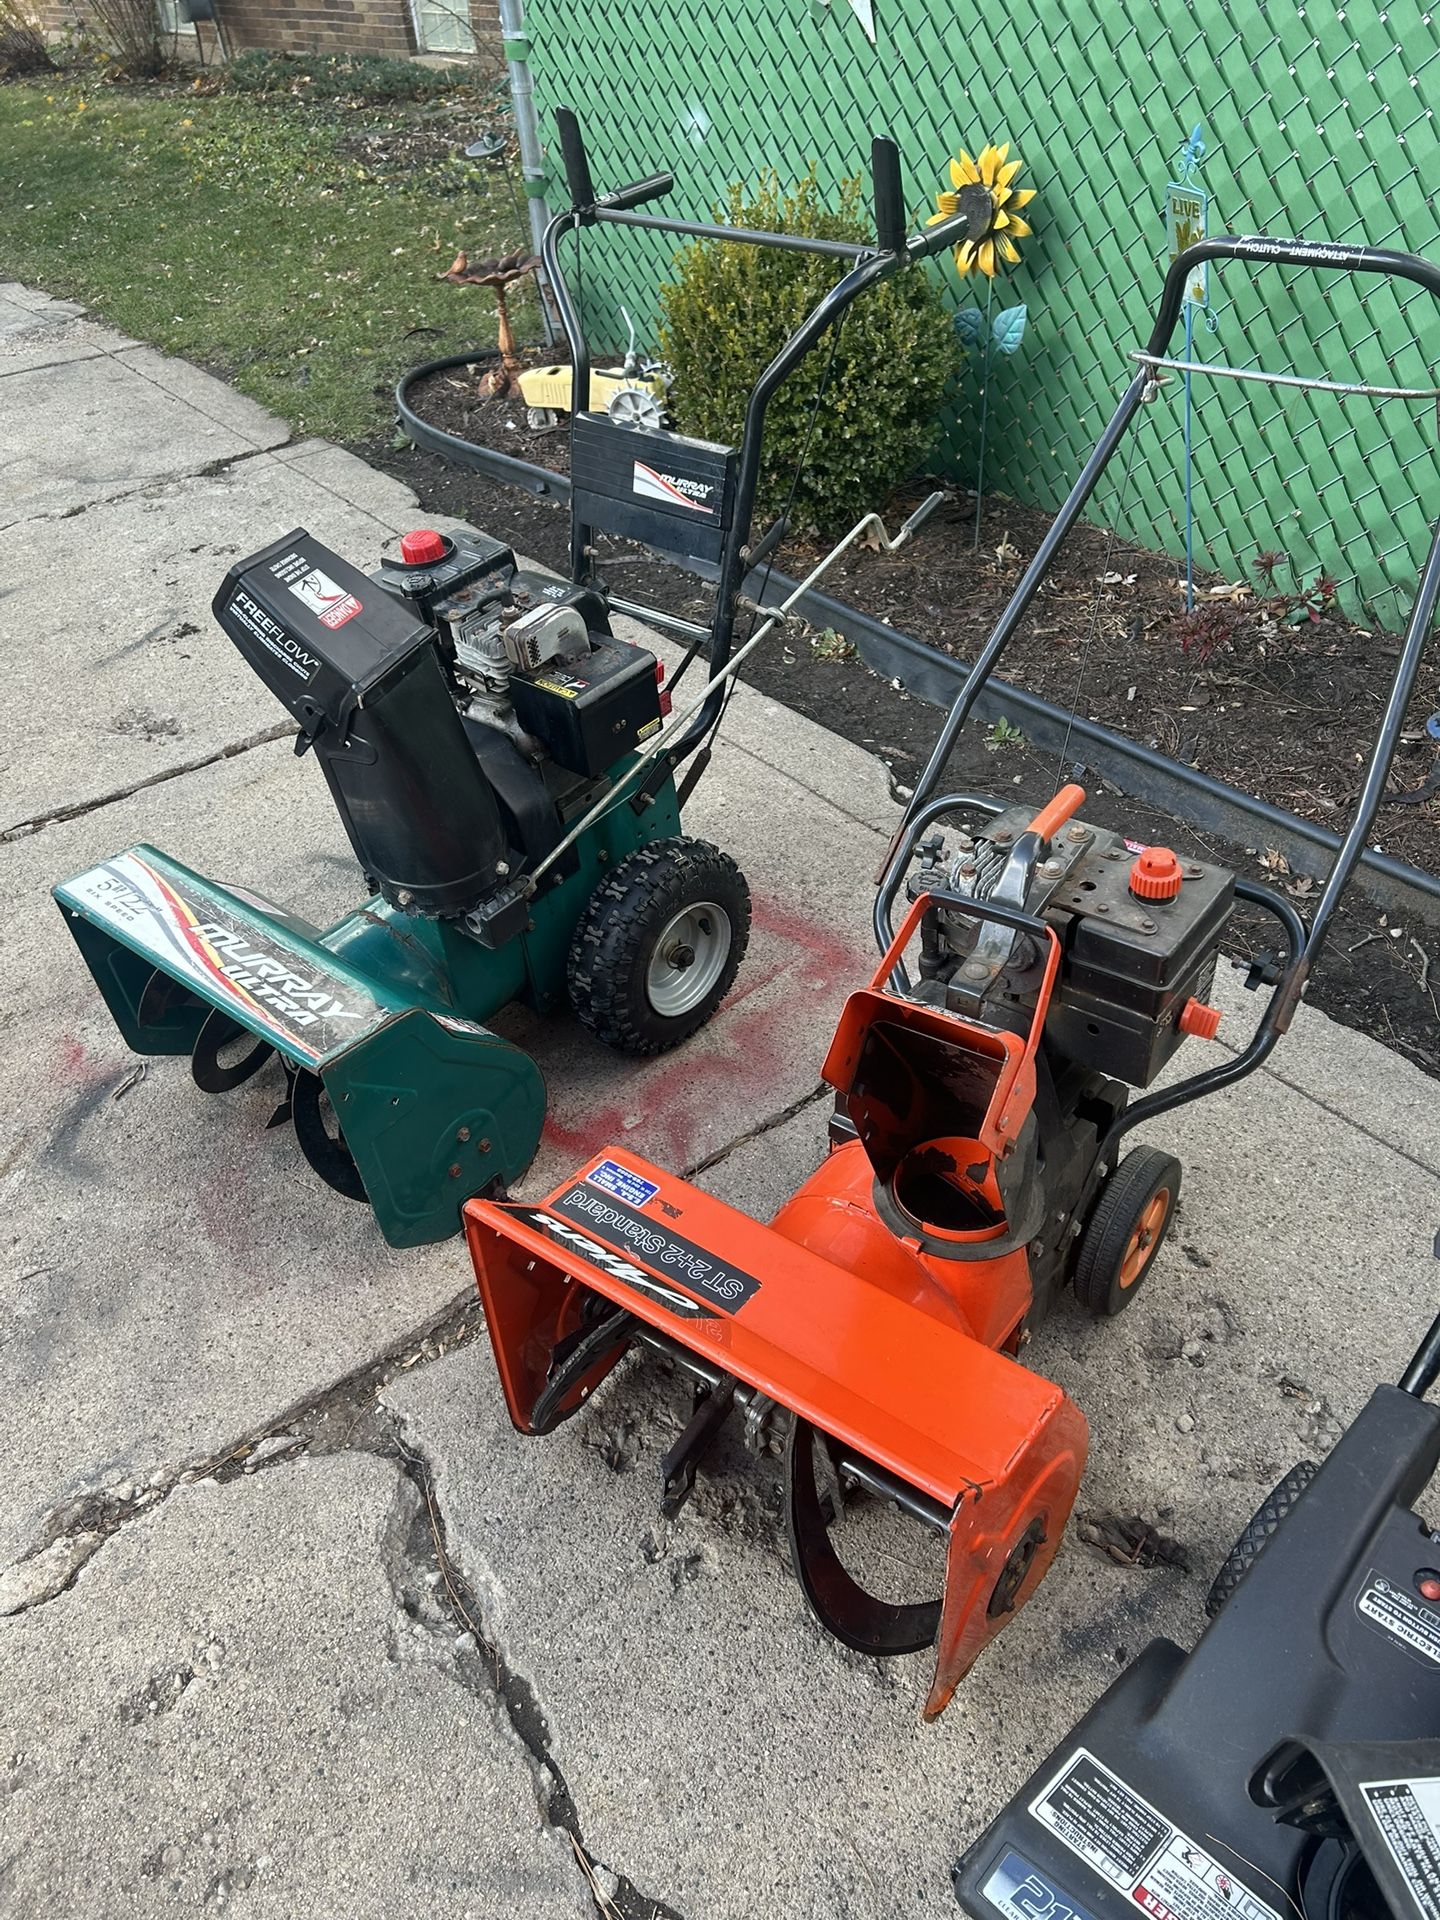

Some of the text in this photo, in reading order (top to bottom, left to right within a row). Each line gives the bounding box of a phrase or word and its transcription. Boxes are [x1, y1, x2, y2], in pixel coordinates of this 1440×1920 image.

[1172, 197, 1200, 219] LIVE
[1247, 243, 1350, 260] ATTACHMENT CLUTCH
[659, 473, 714, 493] MURRAY
[676, 486, 707, 499] ULTRA
[227, 606, 255, 631] VIRTUALLY
[323, 602, 353, 628] DANGER
[234, 591, 314, 664] FREEFLOW
[105, 900, 134, 922] SPEED
[188, 923, 364, 1018] MURRAY
[220, 964, 319, 1026] ULTRA
[591, 1174, 617, 1191] SMALL
[598, 1170, 615, 1181] INC.
[563, 1190, 744, 1300] ST 2+2 Standard
[529, 1213, 700, 1310] Ariens
[1363, 1602, 1396, 1626] START
[1372, 1595, 1393, 1612] START
[1392, 1609, 1402, 1618] TO
[1401, 1615, 1429, 1636] BUTTON
[1054, 1820, 1086, 1850] STARTING
